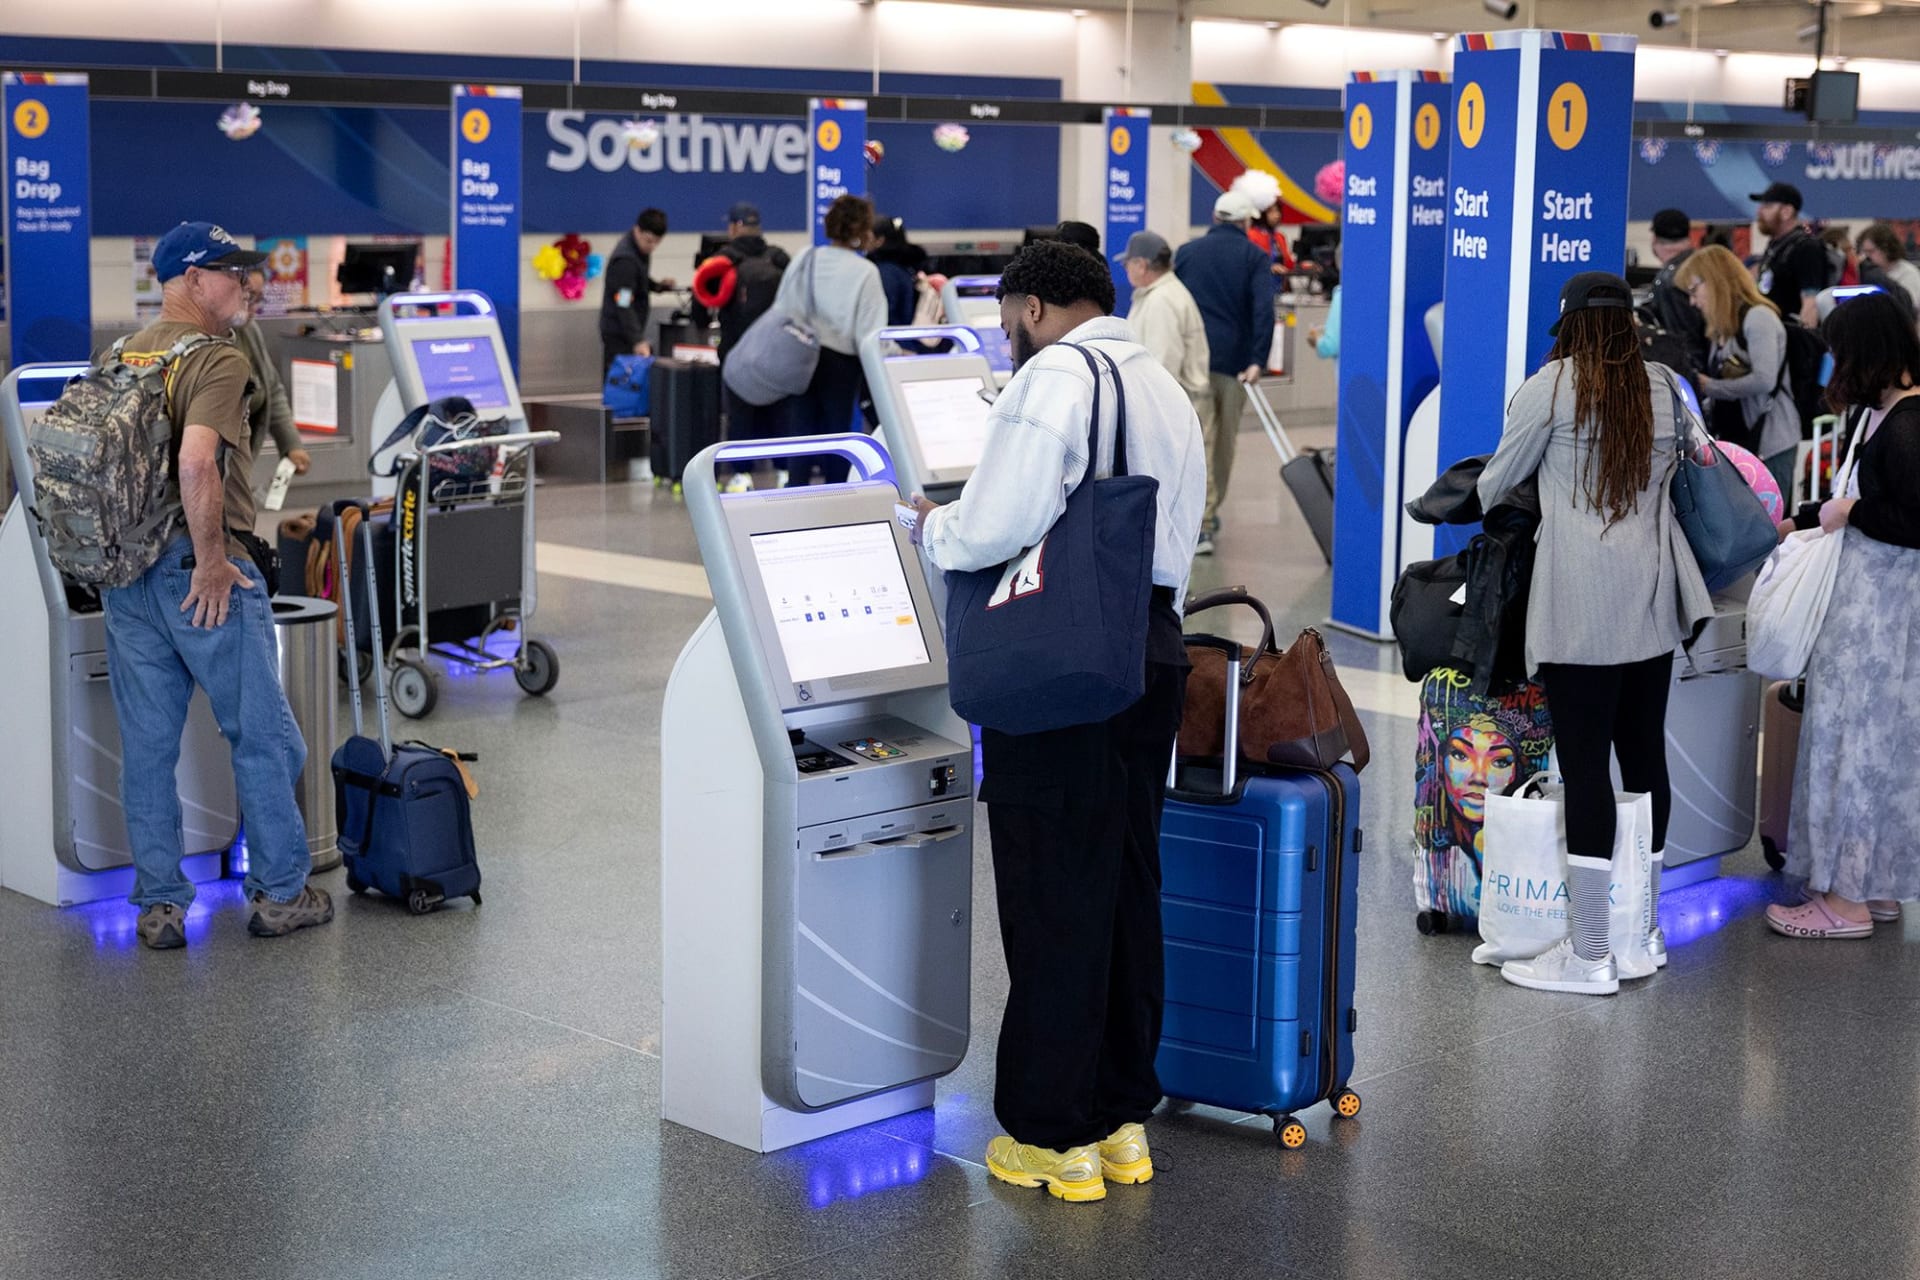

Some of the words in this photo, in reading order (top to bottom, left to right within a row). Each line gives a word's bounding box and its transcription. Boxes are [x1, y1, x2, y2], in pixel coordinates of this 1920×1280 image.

[247, 80, 265, 98] Bag
[267, 80, 290, 98] Drop
[26, 109, 38, 128] 2
[471, 117, 481, 134] 2
[1423, 115, 1431, 137] 1
[1468, 100, 1474, 131] 1
[1562, 100, 1572, 132] 1
[1357, 116, 1363, 138] 1
[546, 109, 810, 173] Southwe
[15, 157, 50, 181] Bag
[461, 158, 491, 181] Bag
[1806, 141, 1920, 179] outhwe
[817, 165, 841, 185] Bag
[1348, 175, 1376, 196] Start
[15, 179, 62, 203] Drop
[461, 178, 499, 200] Drop
[1412, 176, 1445, 197] Start
[1454, 187, 1489, 218] Start
[1542, 190, 1593, 220] Start
[1348, 203, 1376, 225] Here
[1412, 204, 1444, 226] Here
[1453, 228, 1487, 259] Here
[1541, 233, 1592, 262] Here
[1488, 870, 1616, 905] PRIMAK
[1497, 902, 1521, 915] LOVE
[1523, 906, 1543, 918] THE
[1547, 909, 1572, 920] FEEL
[1785, 924, 1826, 937] crocs
